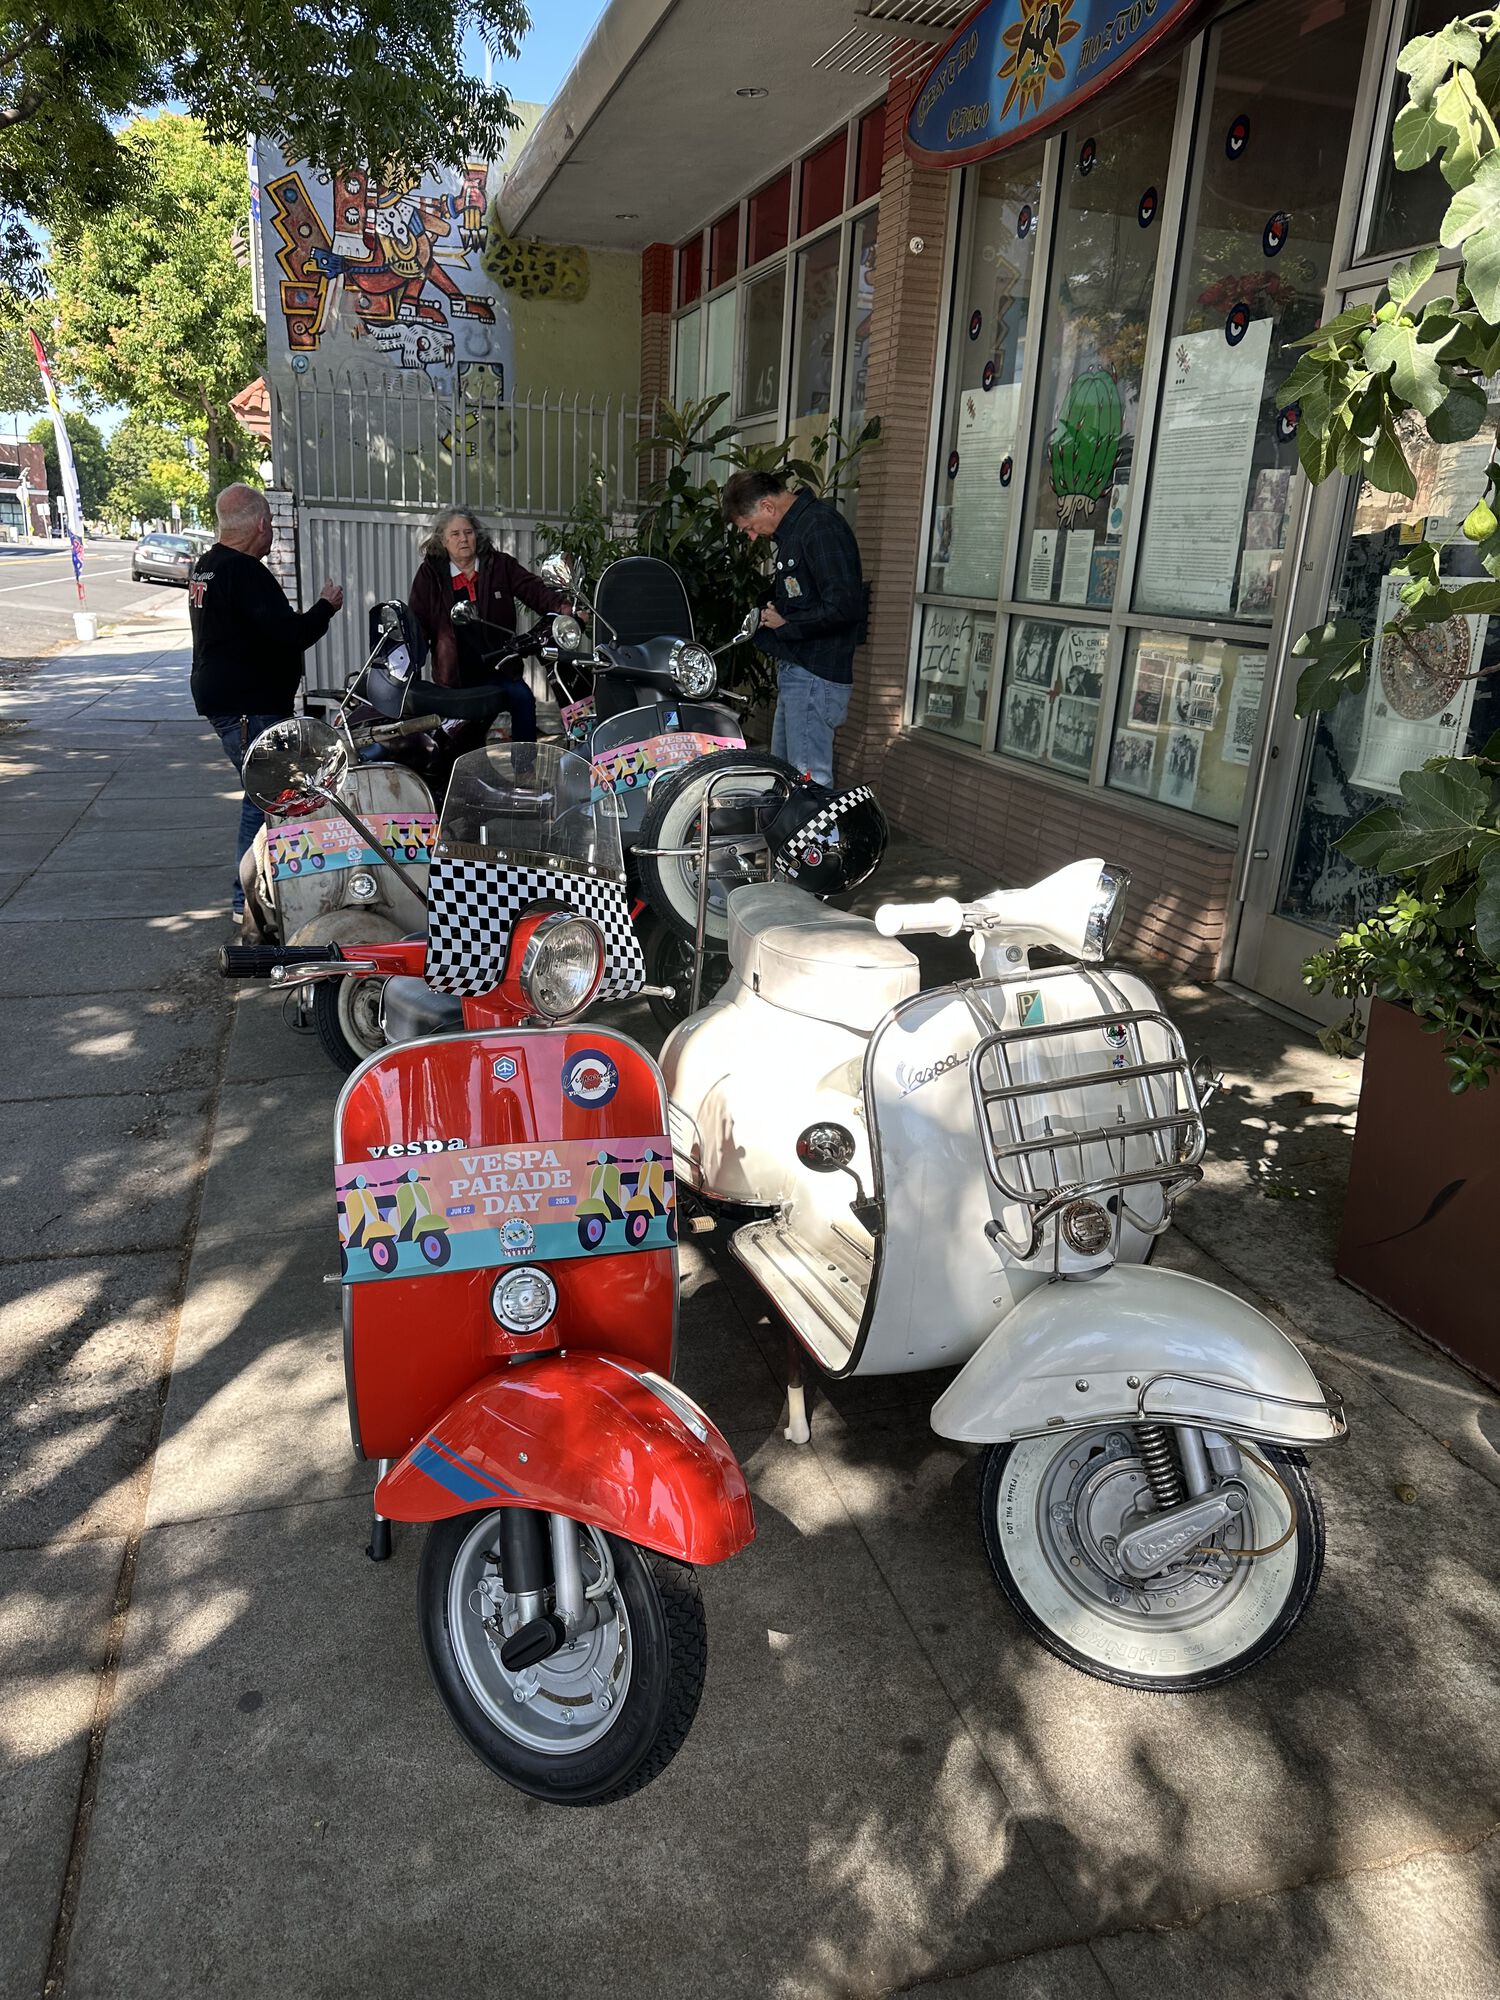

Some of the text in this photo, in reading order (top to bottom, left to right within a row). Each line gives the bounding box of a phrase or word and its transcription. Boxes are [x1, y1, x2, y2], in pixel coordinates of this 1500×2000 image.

[755, 366, 775, 408] 45
[928, 612, 972, 643] Abolish
[922, 644, 960, 675] ICE
[655, 743, 703, 755] PARADE
[657, 735, 697, 746] VESPA
[670, 751, 693, 759] DAY
[325, 817, 372, 831] VESA
[322, 826, 378, 841] PARAE
[338, 836, 366, 848] DAY
[896, 1052, 961, 1100] Vespa
[366, 1137, 468, 1159] vespa
[458, 1149, 561, 1175] VESPA
[449, 1169, 571, 1199] PARADE
[482, 1192, 543, 1216] DAY
[555, 1197, 570, 1205] 2025
[450, 1206, 471, 1215] JUN 22
[1007, 1522, 1015, 1535] DOT
[1070, 1623, 1177, 1663] SHINKO
